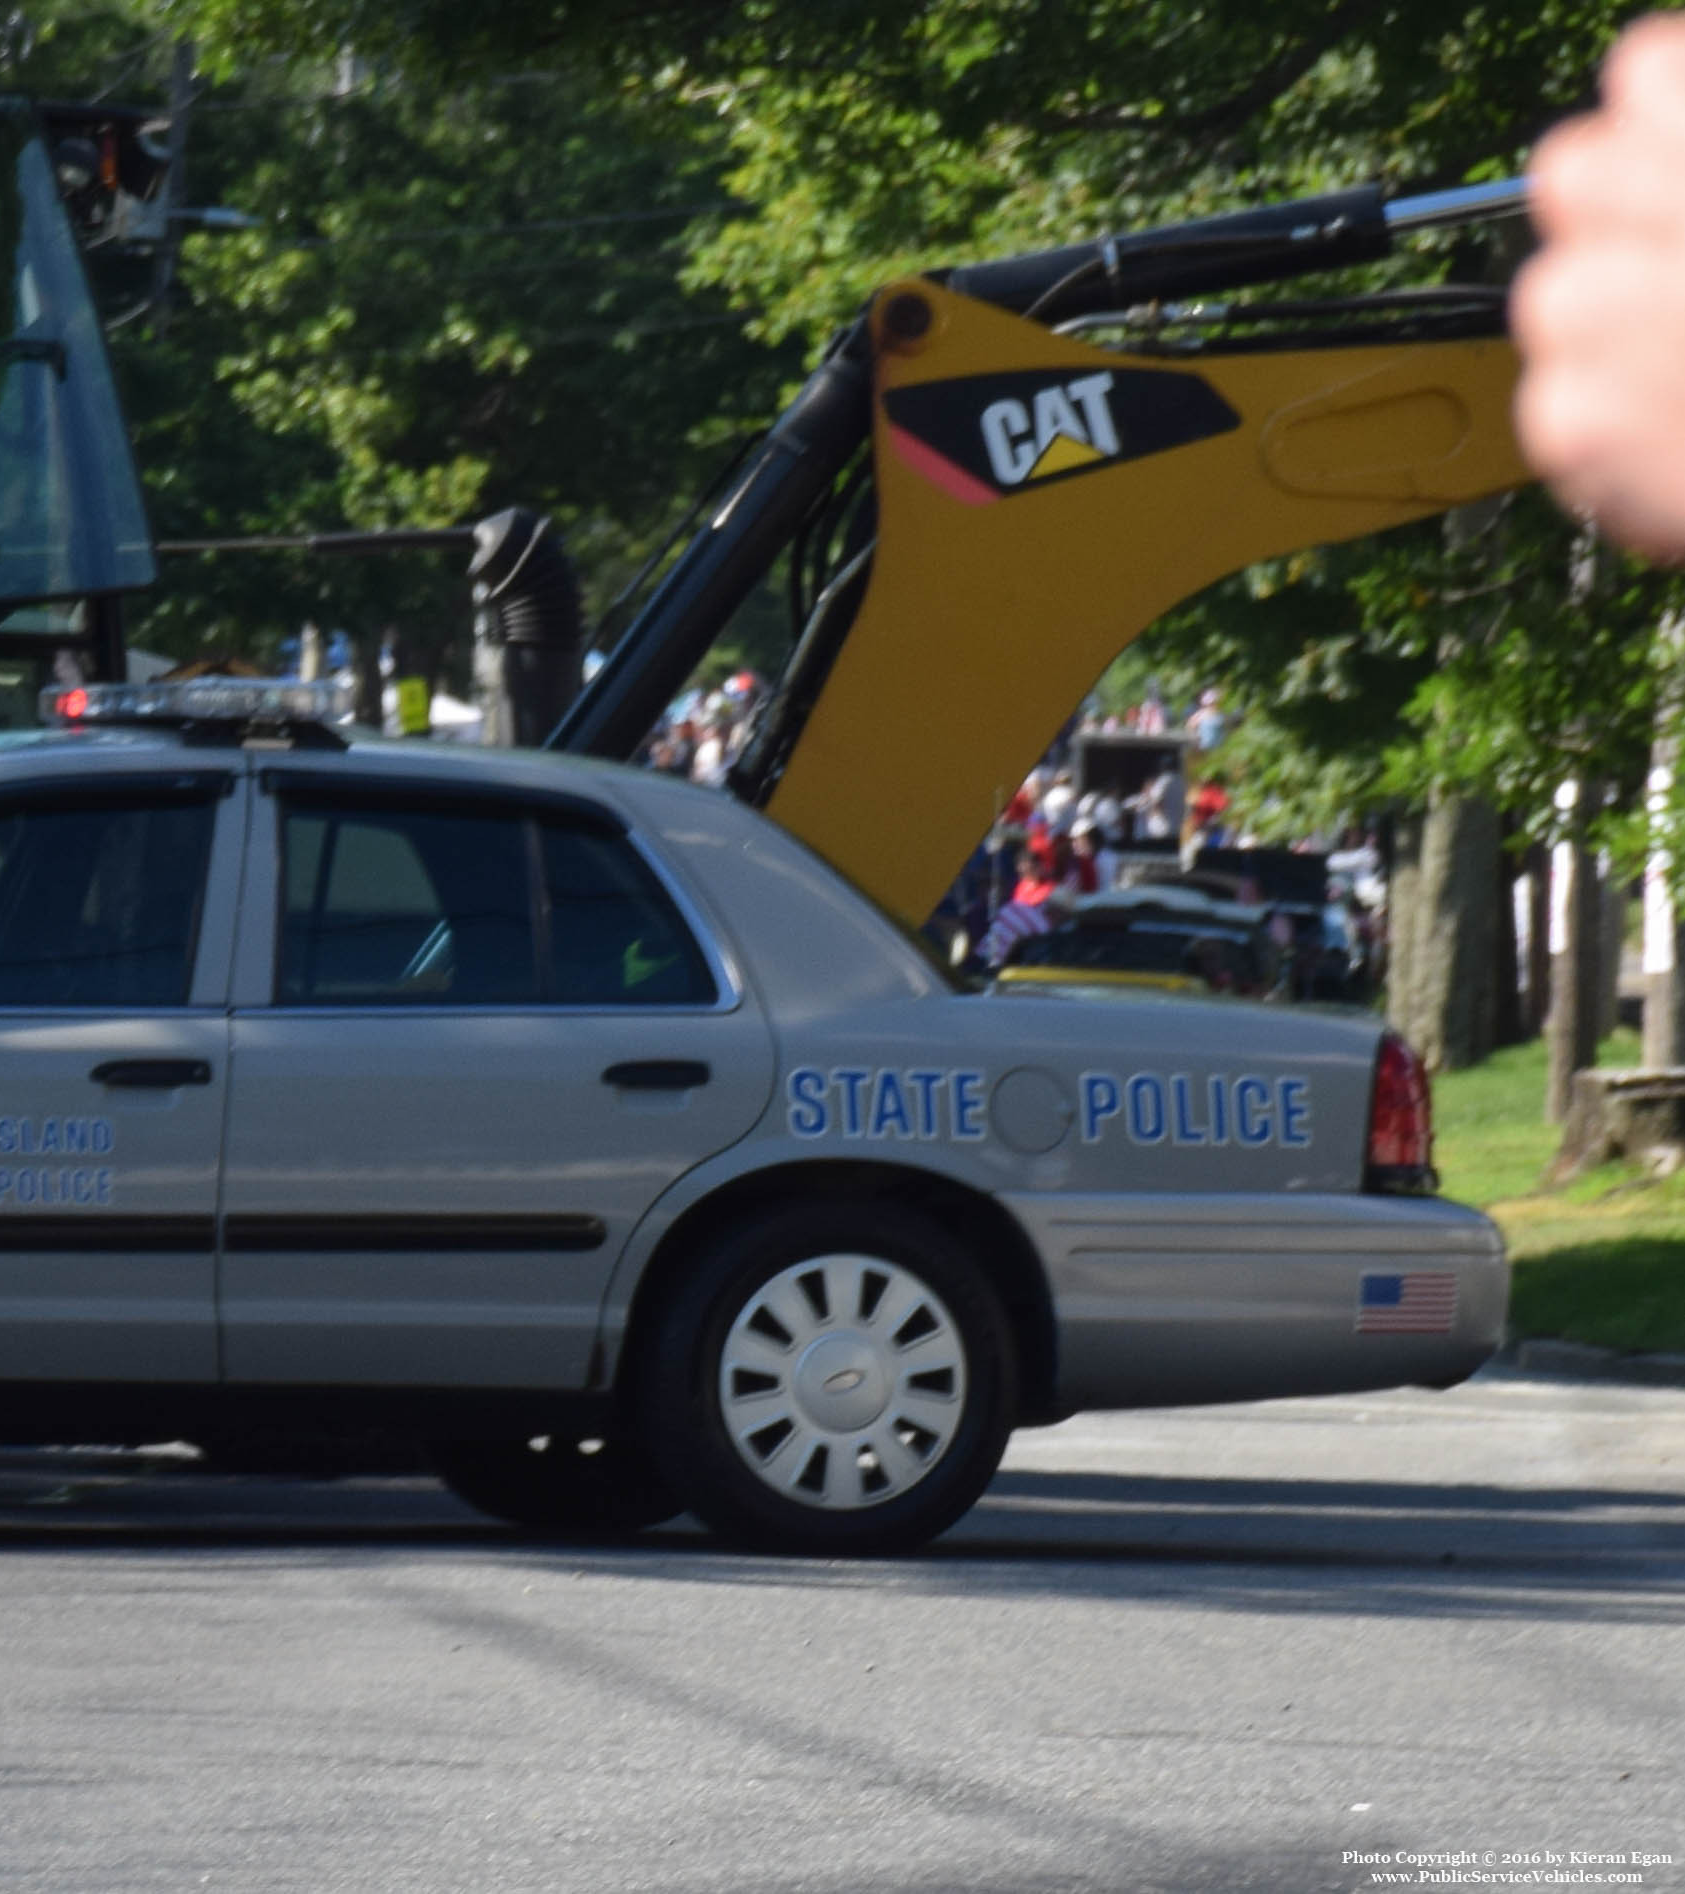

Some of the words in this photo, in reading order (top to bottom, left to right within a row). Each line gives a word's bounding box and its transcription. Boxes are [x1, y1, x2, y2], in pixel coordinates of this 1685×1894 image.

[980, 371, 1121, 485] CAT
[786, 1067, 986, 1141] STATE
[1078, 1073, 1311, 1148] POLICE
